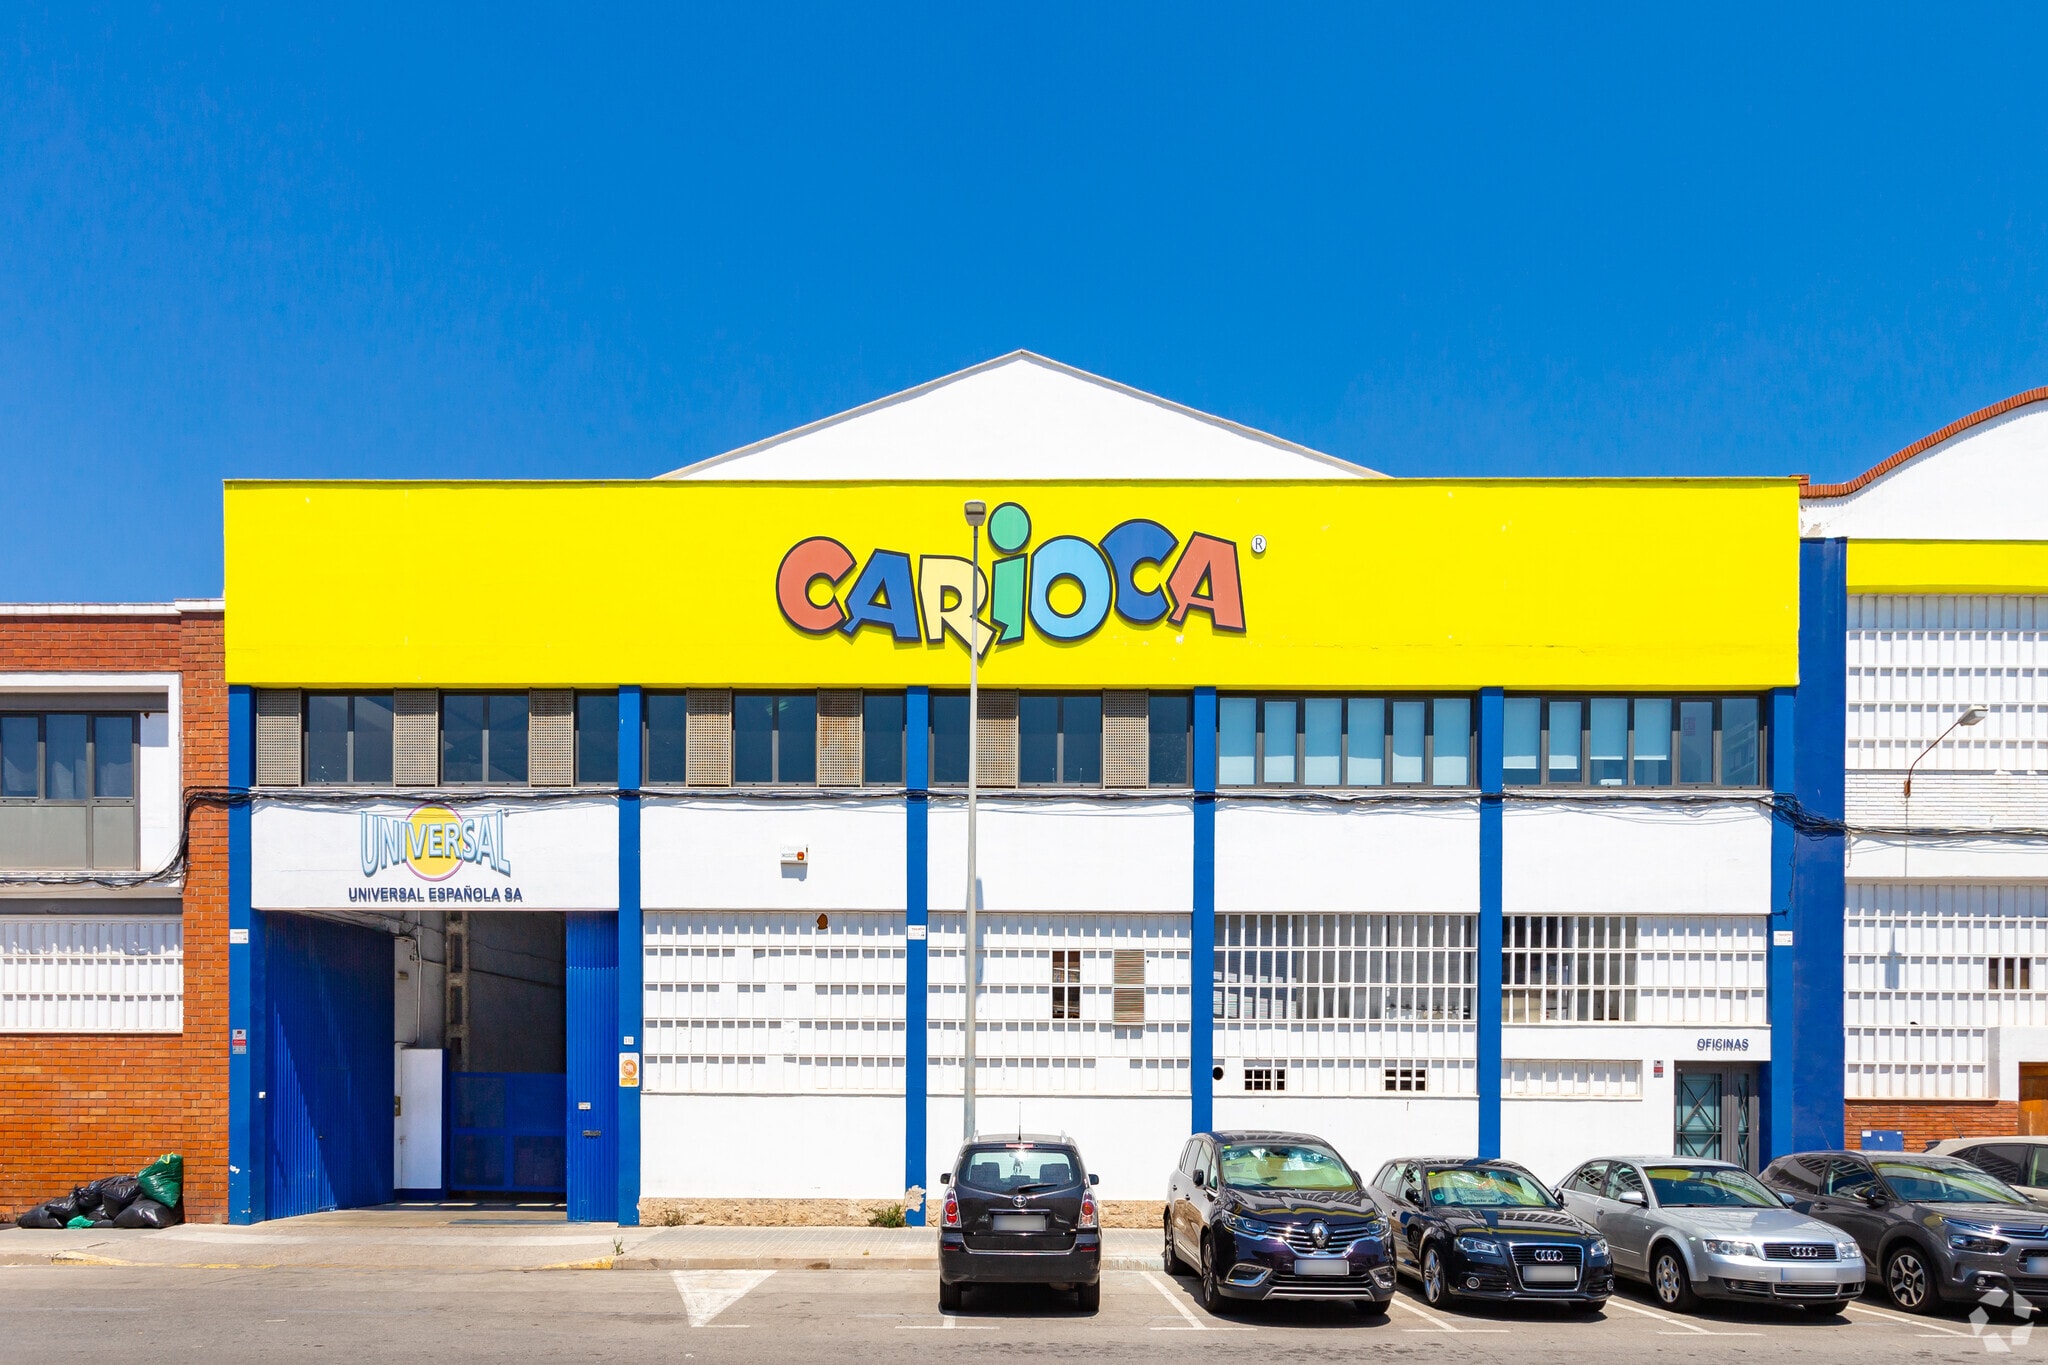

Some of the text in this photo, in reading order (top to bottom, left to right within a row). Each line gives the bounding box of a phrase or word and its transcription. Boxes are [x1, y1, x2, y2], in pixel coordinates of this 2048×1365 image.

[361, 810, 511, 878] UNIVERSAL
[348, 886, 522, 901] UNIVERSAL ESPAÑOLA SA
[1697, 1038, 1749, 1050] OFICINAS
